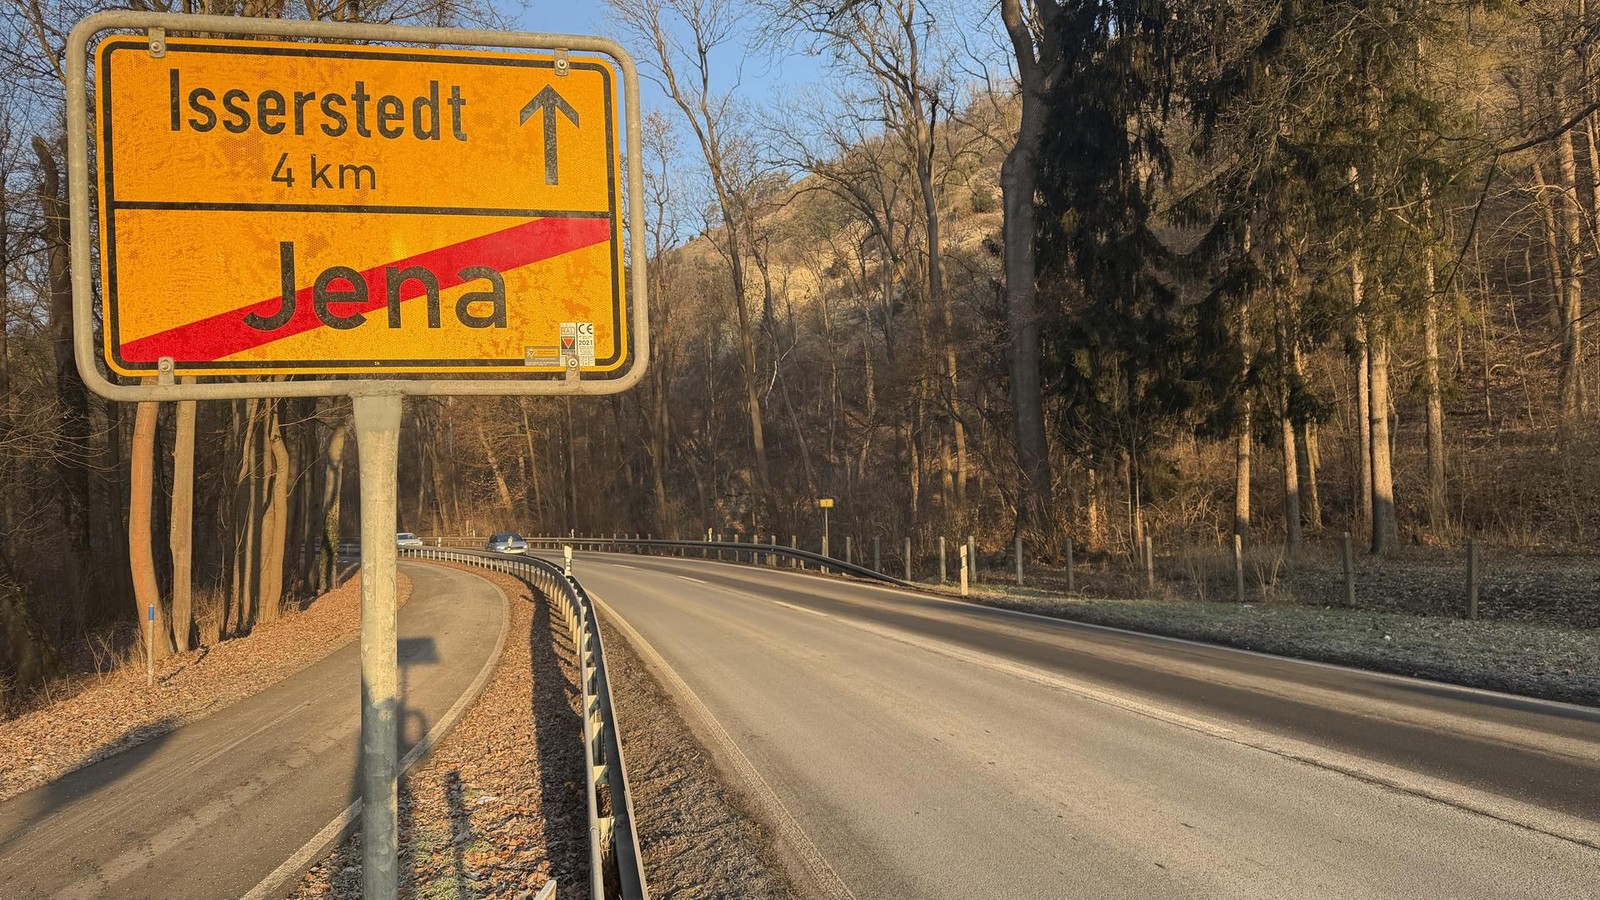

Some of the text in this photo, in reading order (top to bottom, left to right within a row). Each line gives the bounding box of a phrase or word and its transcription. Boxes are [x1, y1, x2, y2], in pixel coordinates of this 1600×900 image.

[169, 69, 467, 141] Isserstedt
[271, 153, 376, 190] 4 km
[243, 242, 507, 331] Jena
